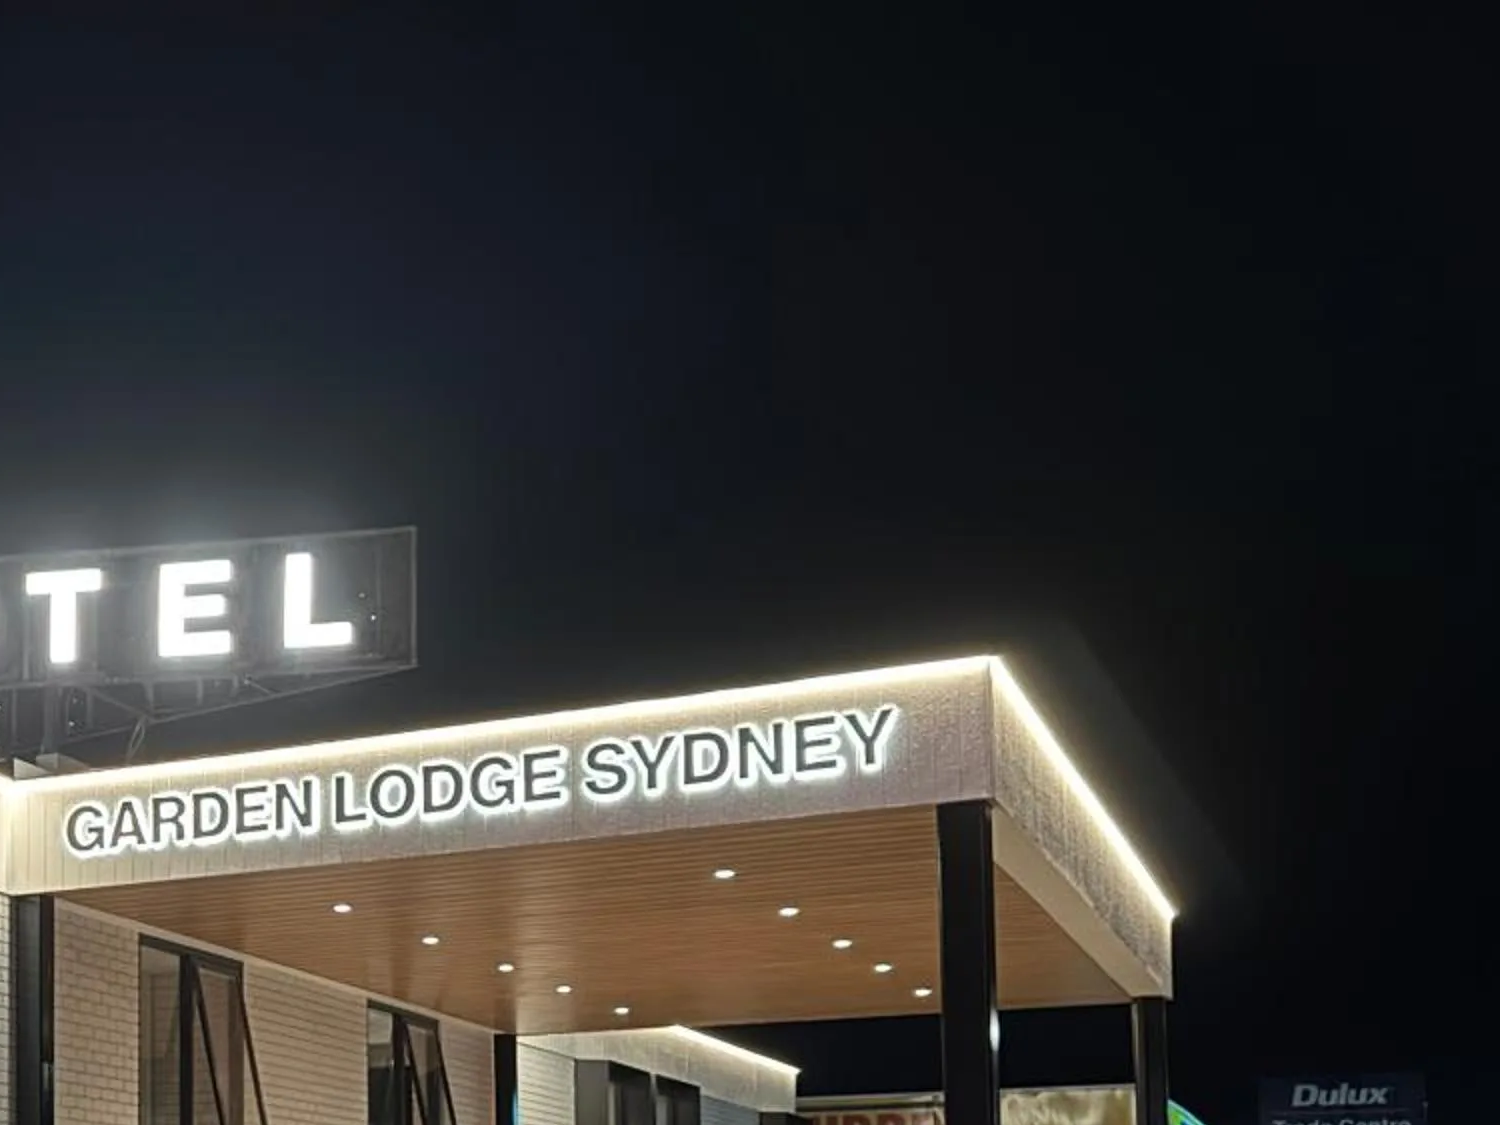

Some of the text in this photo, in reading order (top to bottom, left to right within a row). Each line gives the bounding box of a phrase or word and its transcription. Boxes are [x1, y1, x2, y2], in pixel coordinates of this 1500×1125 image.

[65, 706, 900, 856] GARDEN LODGE SYDNEY
[1292, 1083, 1388, 1107] Dulux
